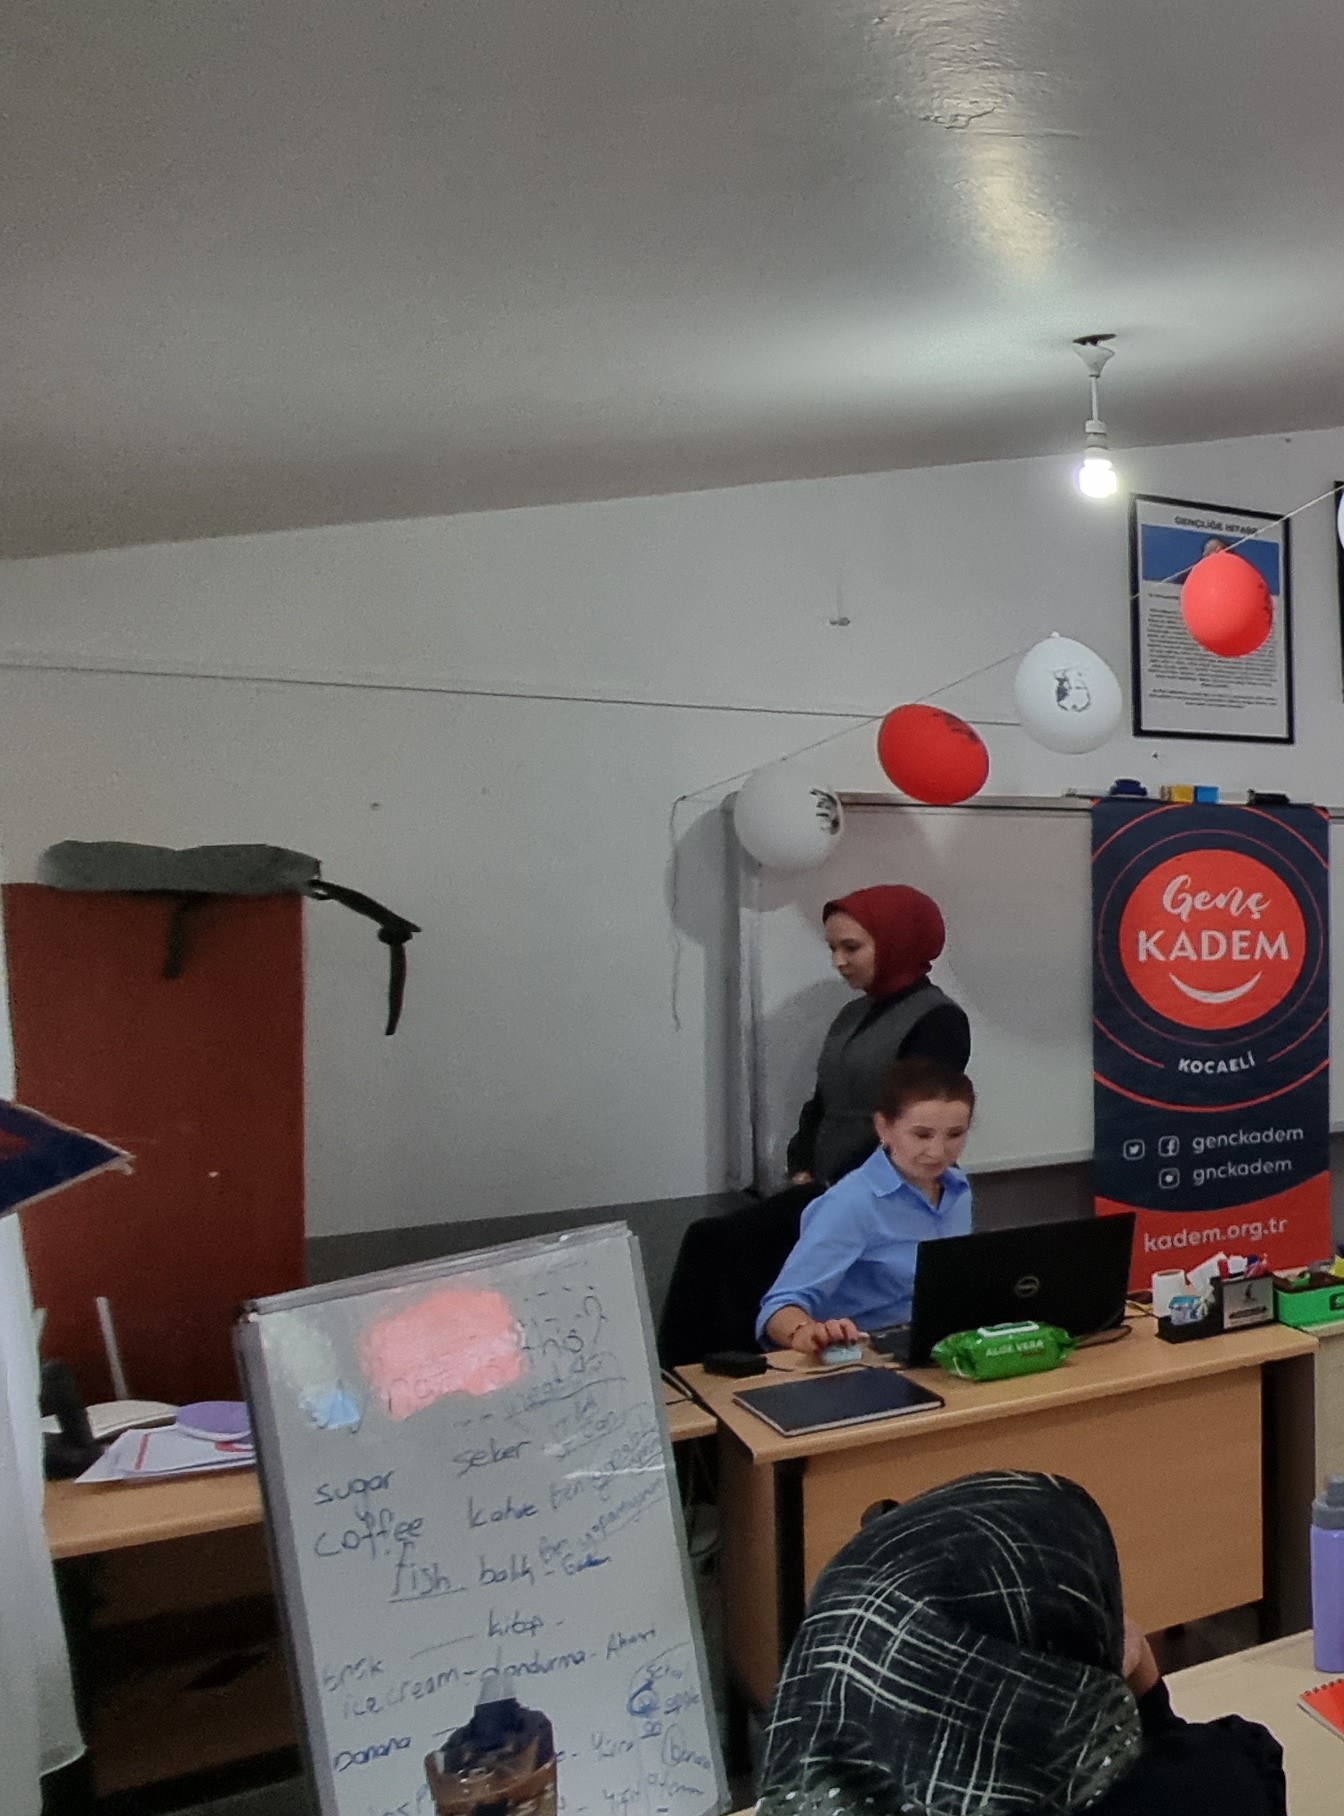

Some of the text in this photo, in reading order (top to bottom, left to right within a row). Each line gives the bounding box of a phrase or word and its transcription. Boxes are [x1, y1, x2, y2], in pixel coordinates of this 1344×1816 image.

[1162, 874, 1271, 922] Genç
[1137, 929, 1290, 962] KADEM
[1177, 1051, 1255, 1074] KOCAELİ
[1191, 1126, 1304, 1154] genckadem
[1192, 1158, 1292, 1187] gnckadem
[1143, 1217, 1289, 1253] kadem.org.tr
[1016, 1338, 1044, 1352] VERA
